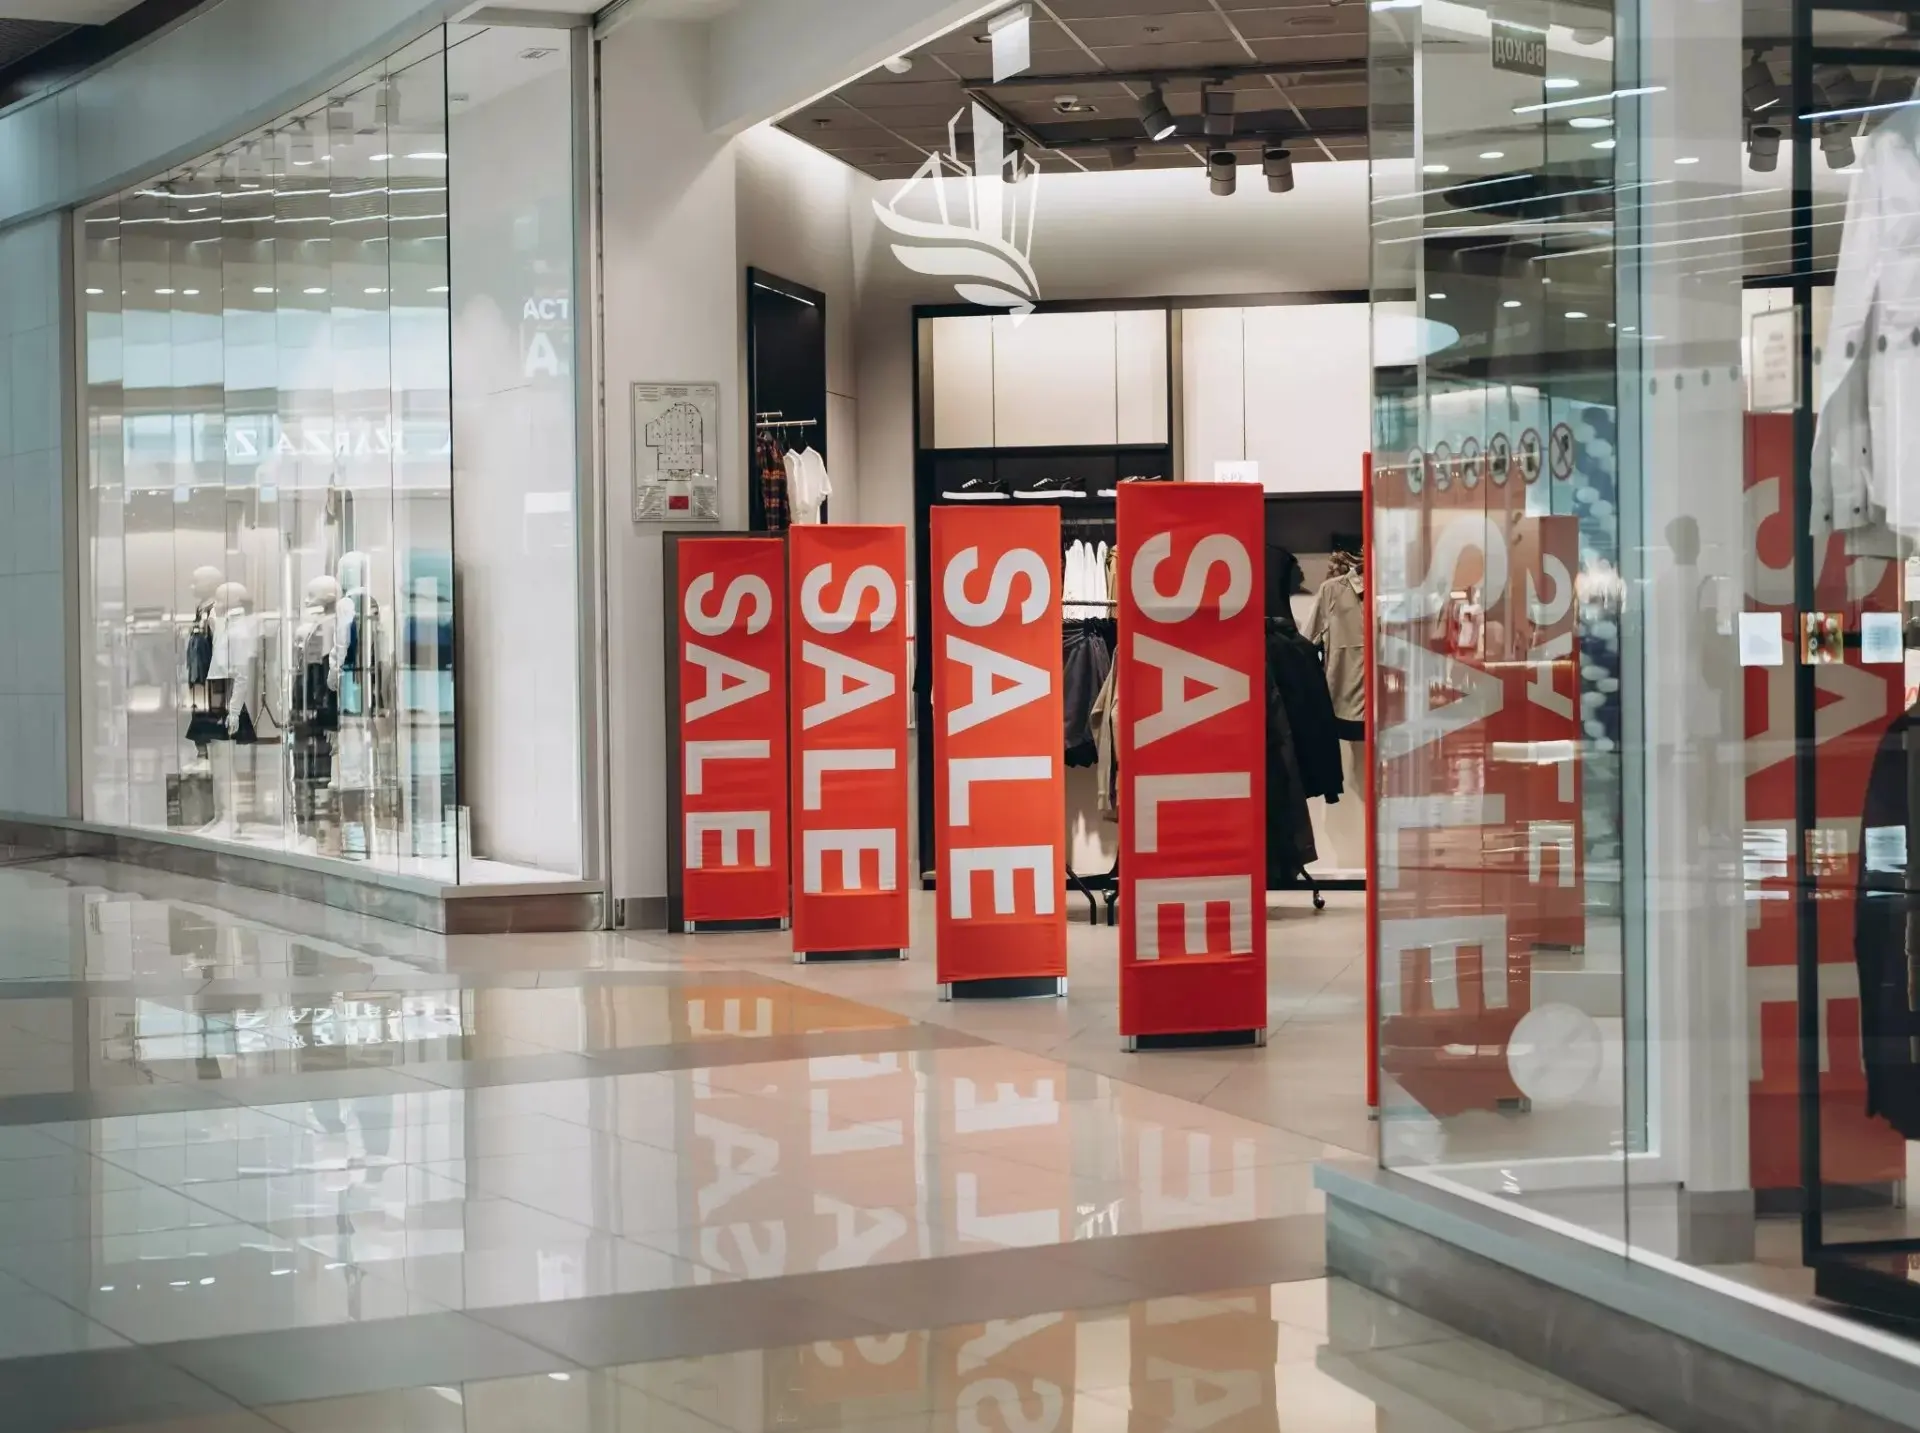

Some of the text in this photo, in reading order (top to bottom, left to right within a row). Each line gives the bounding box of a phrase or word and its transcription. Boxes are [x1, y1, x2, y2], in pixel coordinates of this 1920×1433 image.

[684, 571, 774, 869] SALE
[800, 562, 898, 896] SALE
[942, 546, 1056, 921] SALE
[1130, 531, 1254, 961] SALE
[1379, 514, 1509, 1017] SALE
